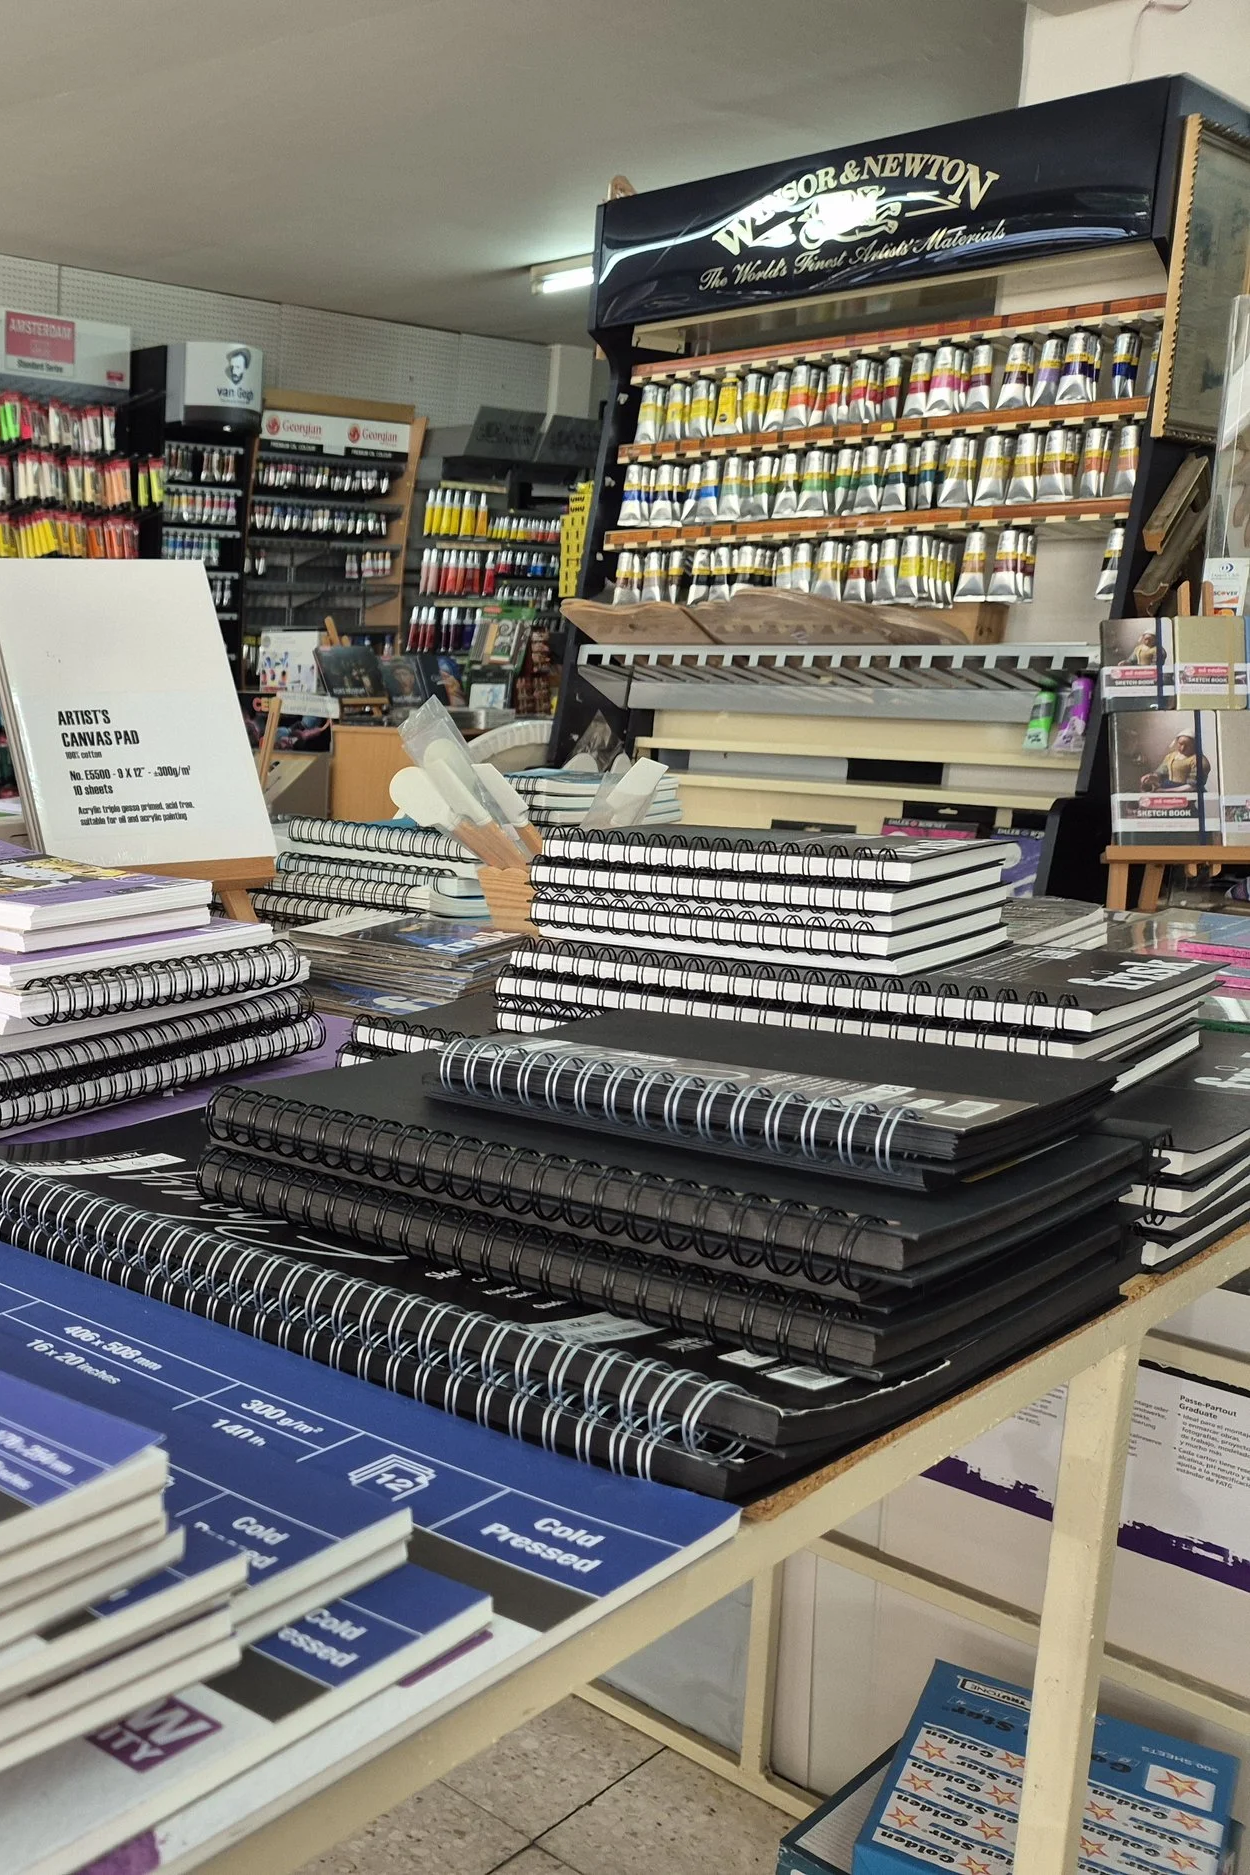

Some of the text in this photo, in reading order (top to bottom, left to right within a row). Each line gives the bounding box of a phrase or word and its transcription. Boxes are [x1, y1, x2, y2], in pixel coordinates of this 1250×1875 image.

[711, 153, 1000, 256] WSOR & NEWTON
[699, 269, 728, 291] The
[732, 258, 787, 285] World's
[794, 250, 847, 275] Finest
[912, 219, 1006, 253] Materials
[10, 318, 71, 339] AMSTERDAM
[217, 386, 235, 397] van
[282, 420, 322, 436] Georgian
[362, 429, 398, 444] Georgian
[58, 709, 111, 726] ARTIST'S
[61, 730, 140, 748] CANVAS PAD
[80, 750, 102, 759] cotton
[70, 770, 84, 782] No.
[85, 768, 111, 781] E5500
[126, 768, 132, 778] X
[73, 784, 114, 796] 10 sheets
[78, 805, 101, 816] Acrylic
[102, 803, 121, 814] triple
[122, 803, 140, 814] gesso
[165, 801, 178, 810] acid
[80, 812, 188, 826] suitable for oil and acrylic painting
[1136, 808, 1192, 818] SKETCH BOOK
[63, 1324, 94, 1343] 406
[102, 1341, 139, 1361] 508
[133, 1354, 163, 1371] mm
[26, 1338, 53, 1353] 16
[54, 1350, 85, 1367] 20
[75, 1361, 122, 1386] inches
[240, 1398, 288, 1420] 300
[1179, 1403, 1218, 1420] Graduate
[1180, 1394, 1237, 1417] Passe-Partout
[380, 1470, 413, 1491] 12
[231, 1514, 292, 1546] Cold
[533, 1515, 608, 1550] Cold
[480, 1520, 605, 1574] Pressed
[926, 1729, 994, 1759] Golden
[911, 1761, 981, 1794] Golden
[880, 1830, 955, 1864] Golden
